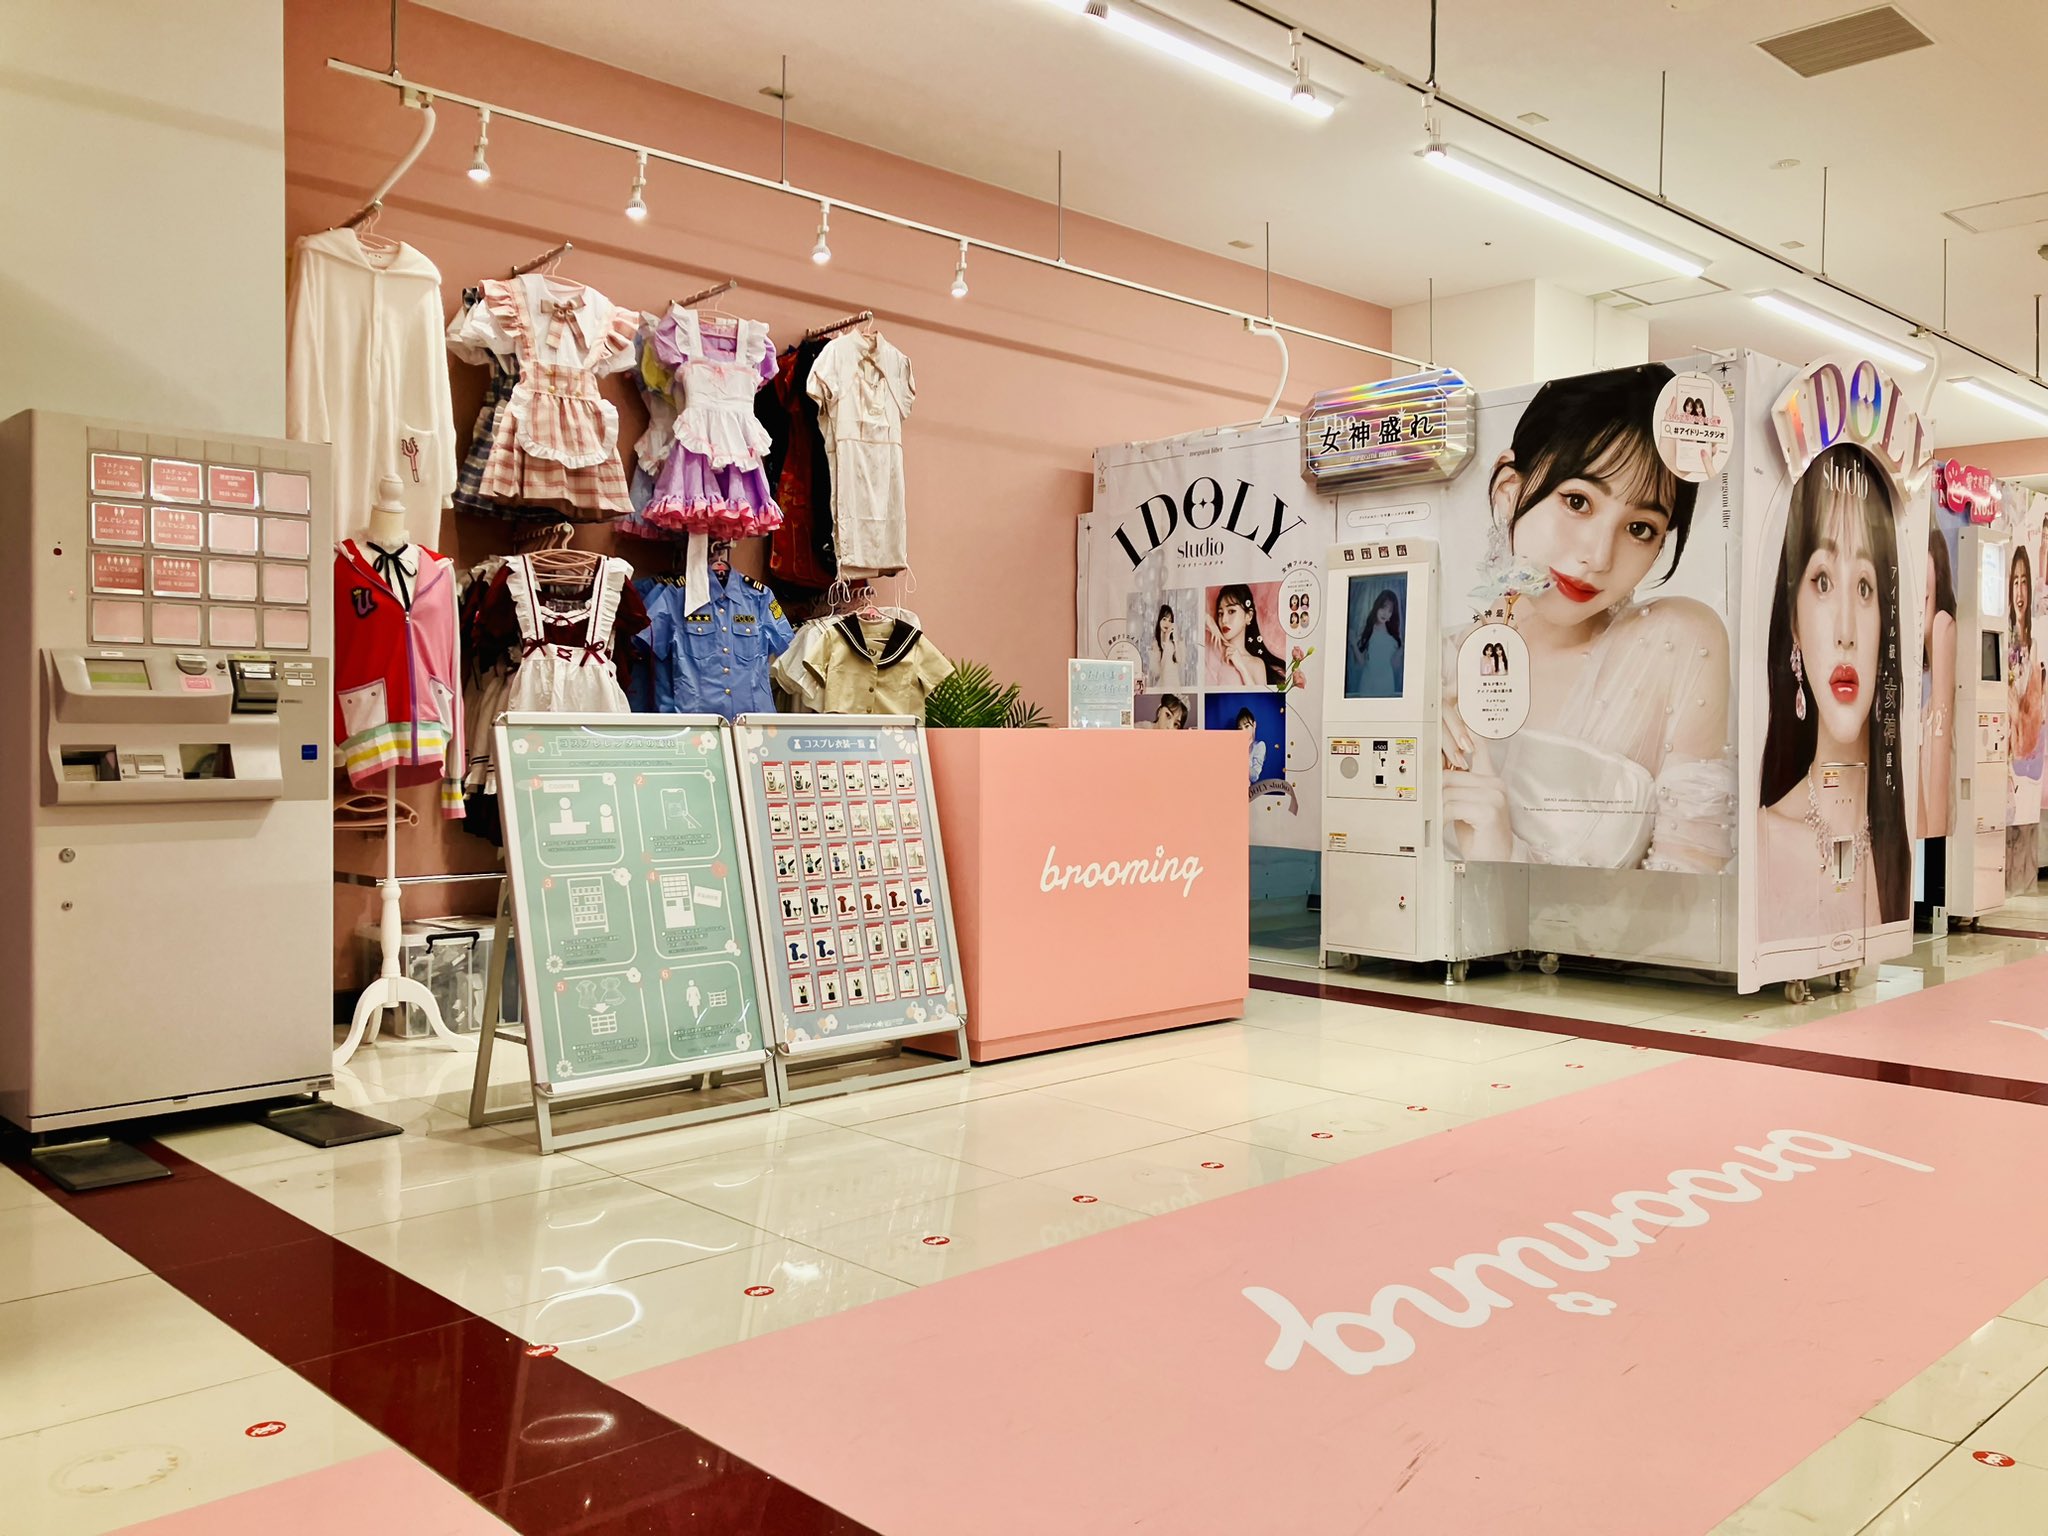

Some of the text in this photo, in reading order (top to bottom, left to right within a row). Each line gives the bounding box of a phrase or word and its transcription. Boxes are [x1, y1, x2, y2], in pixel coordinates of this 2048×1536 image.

[1319, 413, 1434, 455] 女神盛れ
[1673, 426, 1726, 440] #アイドリースタジオ
[1823, 456, 1869, 500] studio
[1111, 476, 1307, 572] IDOLY
[1176, 537, 1224, 559] studio
[1472, 609, 1515, 624] 女神盛れ
[804, 738, 865, 749] コスプレ衣装一覧
[636, 776, 644, 785] 2
[649, 872, 656, 881] 4
[1040, 845, 1204, 898] brooming
[544, 879, 552, 888] 3
[661, 969, 669, 979] 6
[556, 982, 565, 992] 5
[1241, 1127, 1936, 1376] brooming
